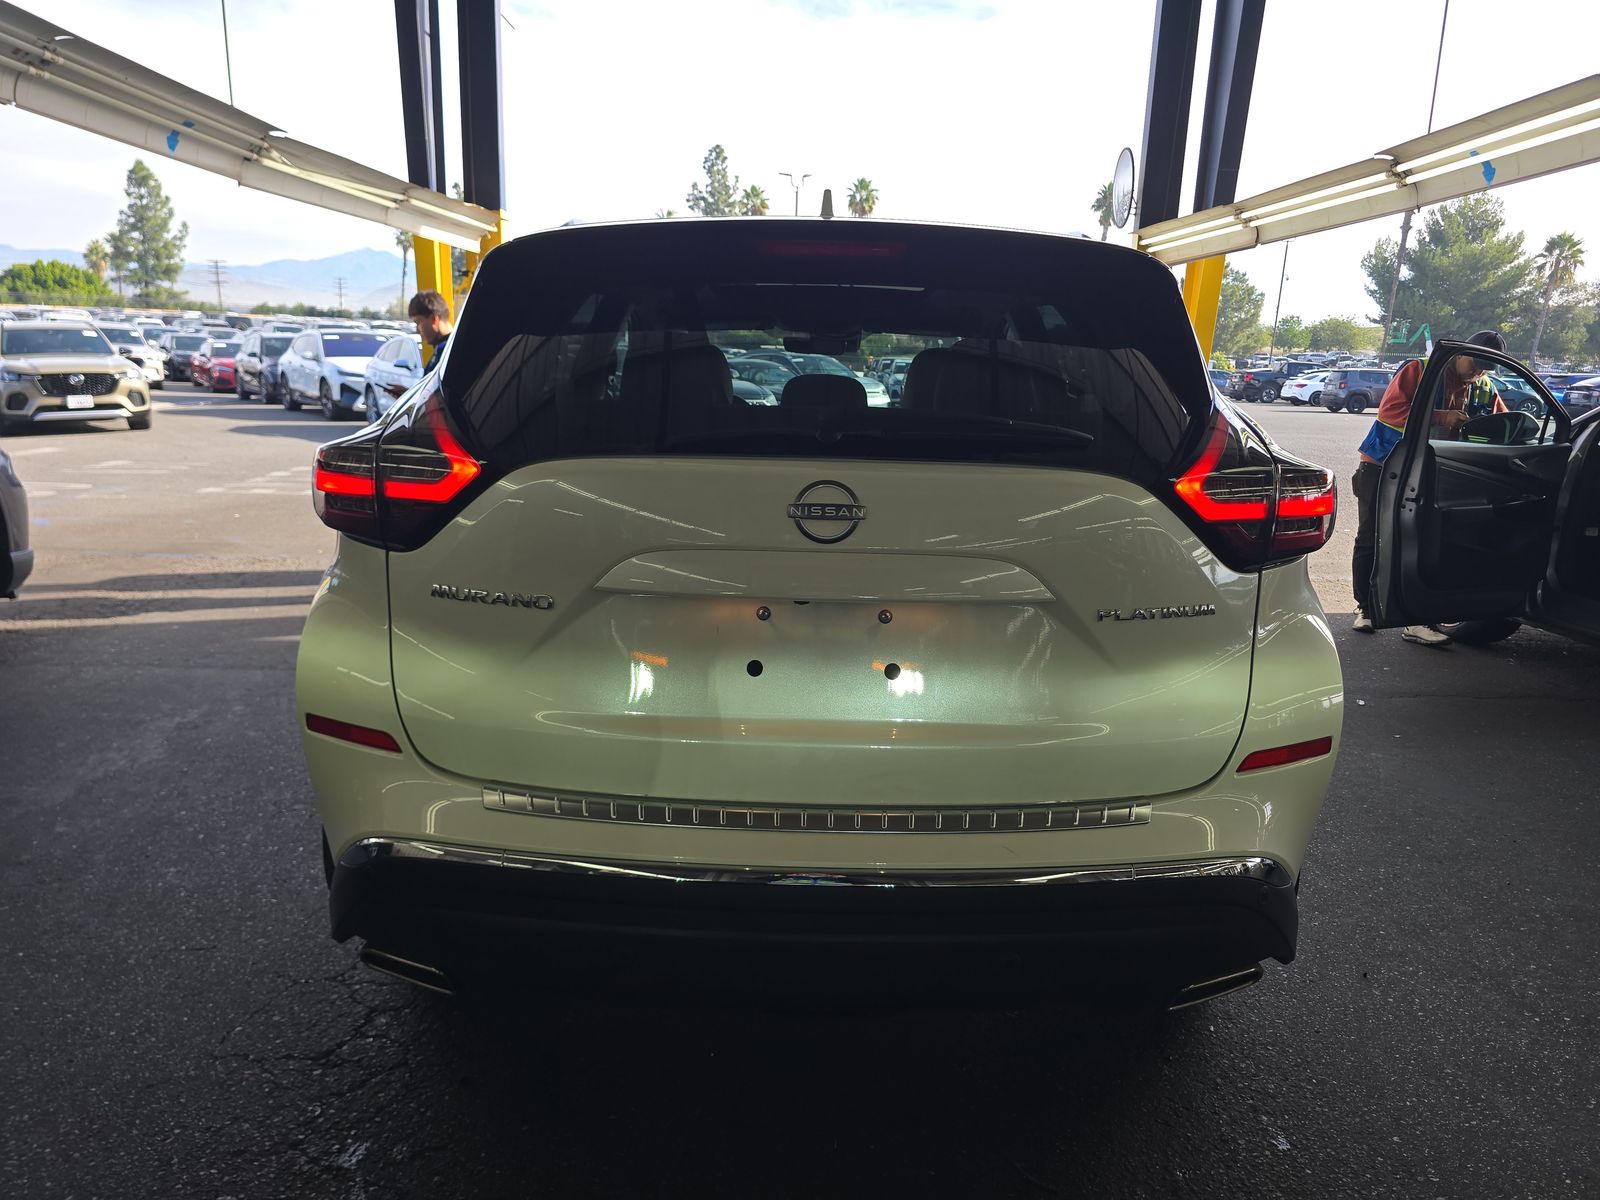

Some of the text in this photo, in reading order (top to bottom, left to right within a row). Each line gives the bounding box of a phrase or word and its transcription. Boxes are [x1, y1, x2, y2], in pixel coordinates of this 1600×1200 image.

[790, 506, 864, 517] NISSAN
[431, 584, 554, 609] MURANO
[1097, 604, 1216, 621] PLATINUM
